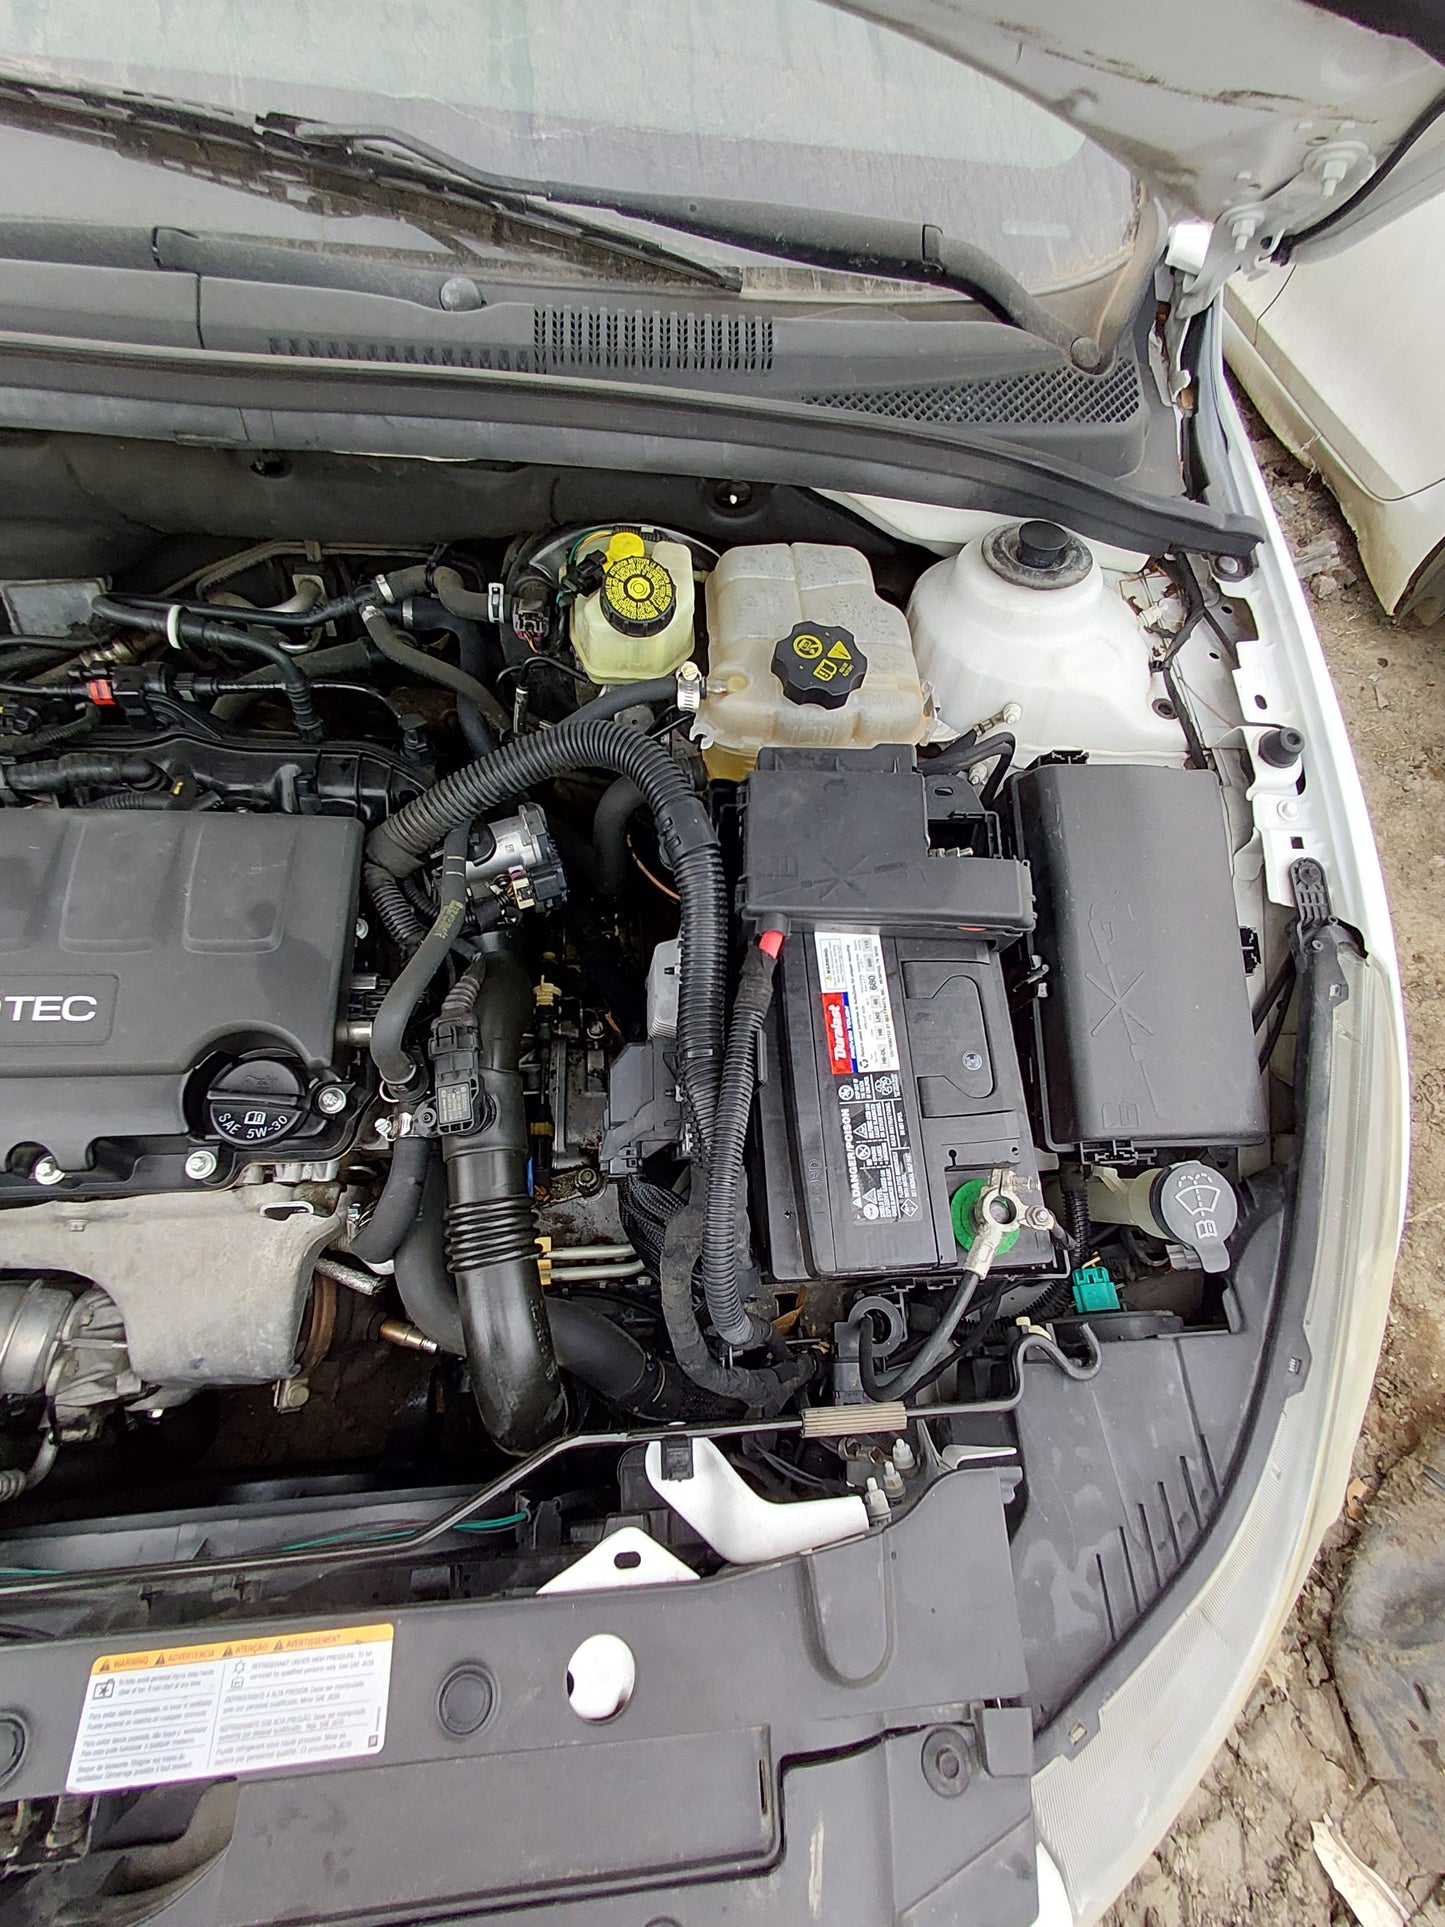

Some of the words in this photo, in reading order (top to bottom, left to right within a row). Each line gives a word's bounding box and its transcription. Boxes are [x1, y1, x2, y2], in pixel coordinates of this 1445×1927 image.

[867, 975, 877, 990] 680
[0, 995, 98, 1021] TEC
[827, 1004, 846, 1060] Duralast
[847, 1030, 855, 1058] PROVEN
[218, 1112, 242, 1135] SAE
[246, 1115, 288, 1139] 5W-30
[840, 1108, 860, 1197] DANGER/POISON
[113, 1656, 149, 1668] WARNING
[167, 1649, 215, 1662] ADVERTENCIA
[286, 1634, 340, 1647] AVERTISSEMENT
